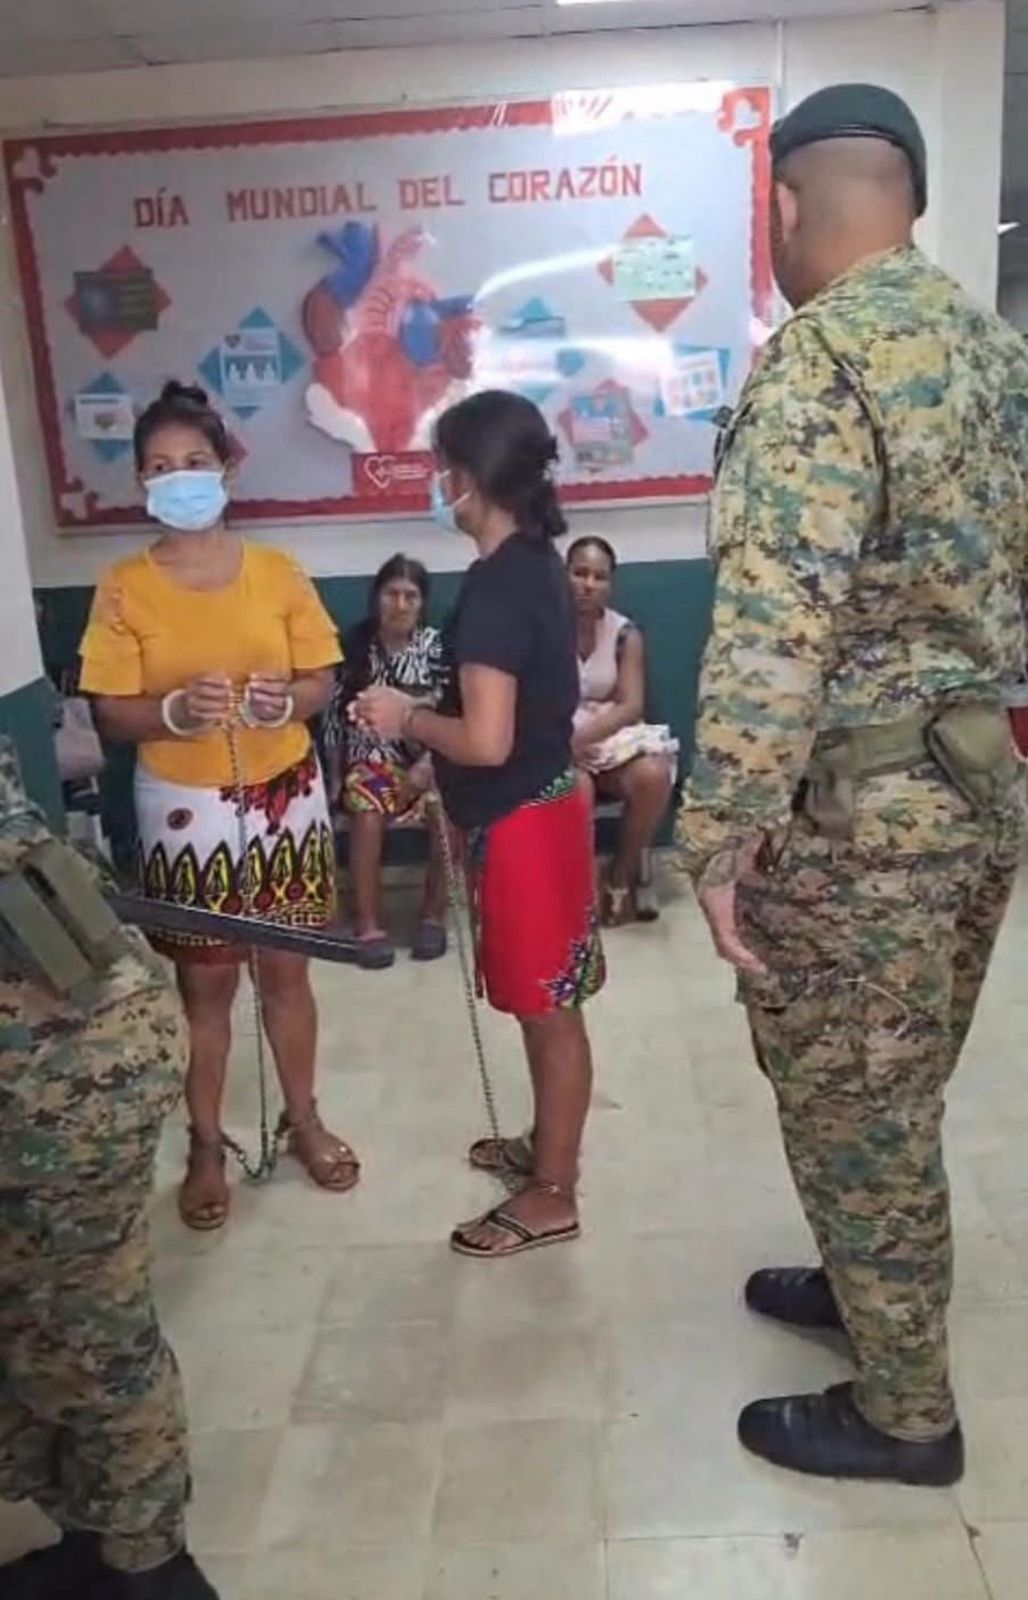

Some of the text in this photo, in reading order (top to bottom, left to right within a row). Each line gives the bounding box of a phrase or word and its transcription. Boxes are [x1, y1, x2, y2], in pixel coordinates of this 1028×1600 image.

[133, 154, 642, 228] DÍA MUNDIAL DEL CORAZÓN
